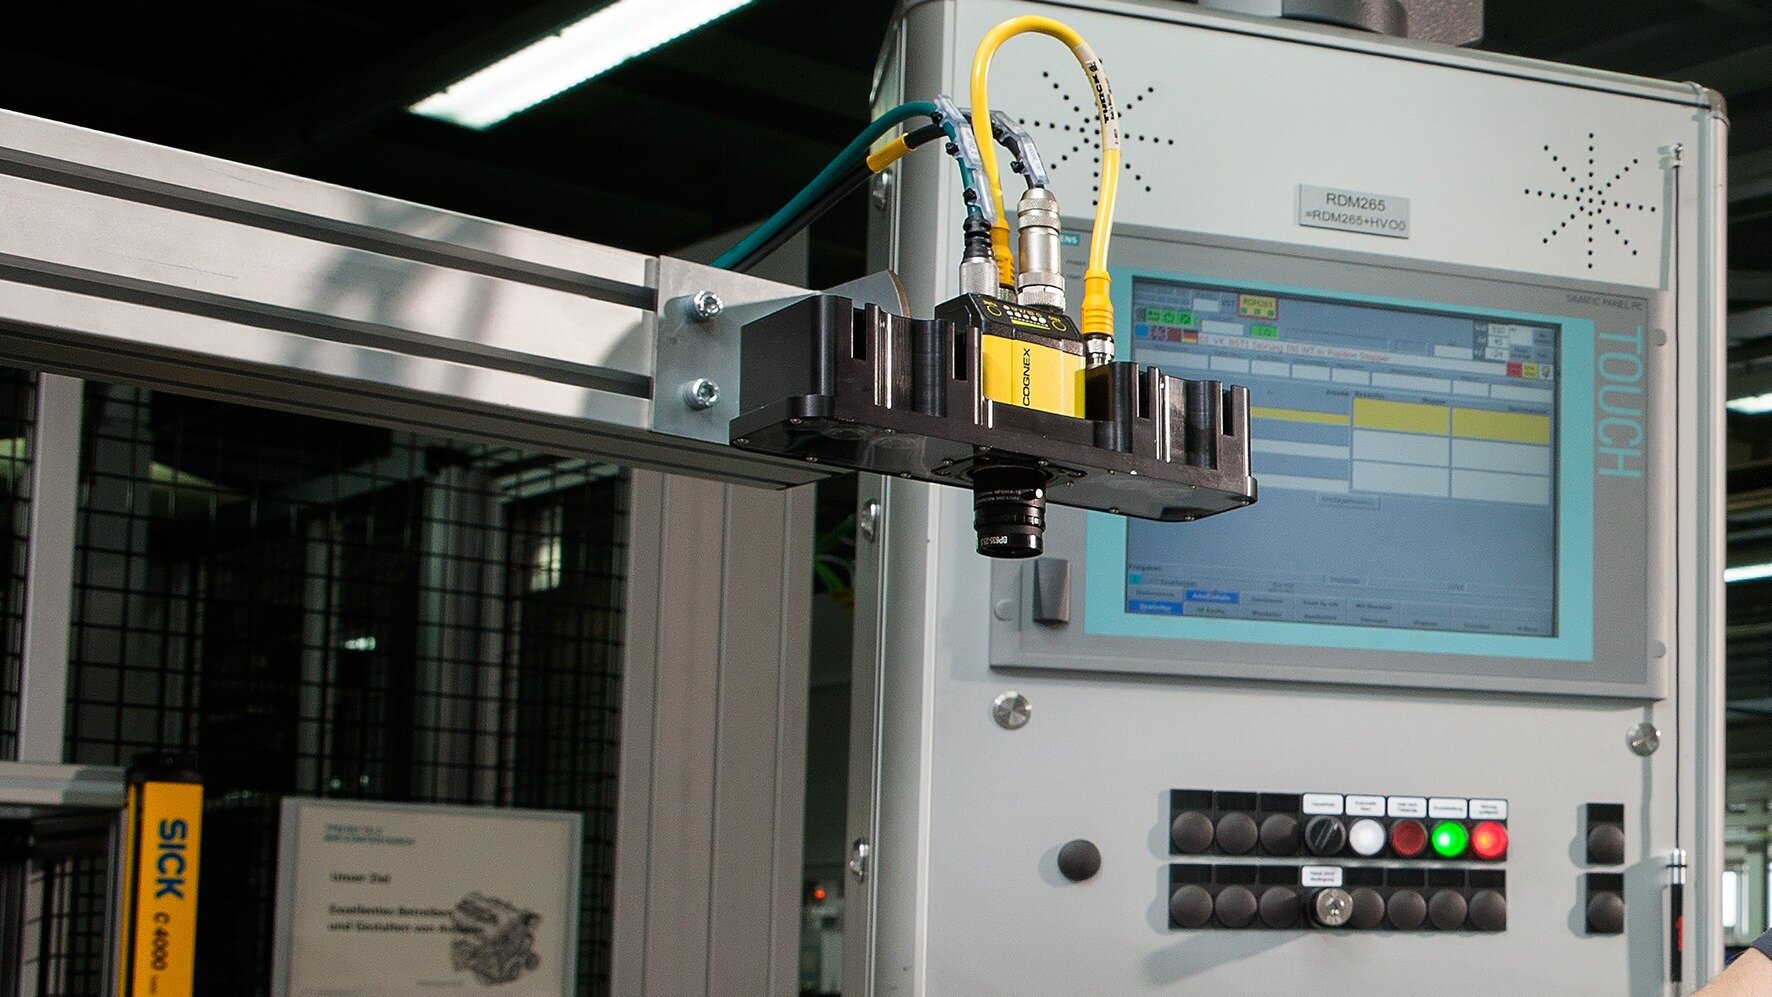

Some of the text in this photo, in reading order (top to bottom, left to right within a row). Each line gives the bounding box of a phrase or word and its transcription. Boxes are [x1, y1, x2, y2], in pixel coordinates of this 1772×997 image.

[1326, 192, 1386, 212] RDM265
[1022, 347, 1031, 407] COGNEX
[1597, 325, 1643, 479] TOUCH
[155, 818, 188, 901] SICK
[153, 911, 171, 926] C
[151, 928, 171, 971] 4000
